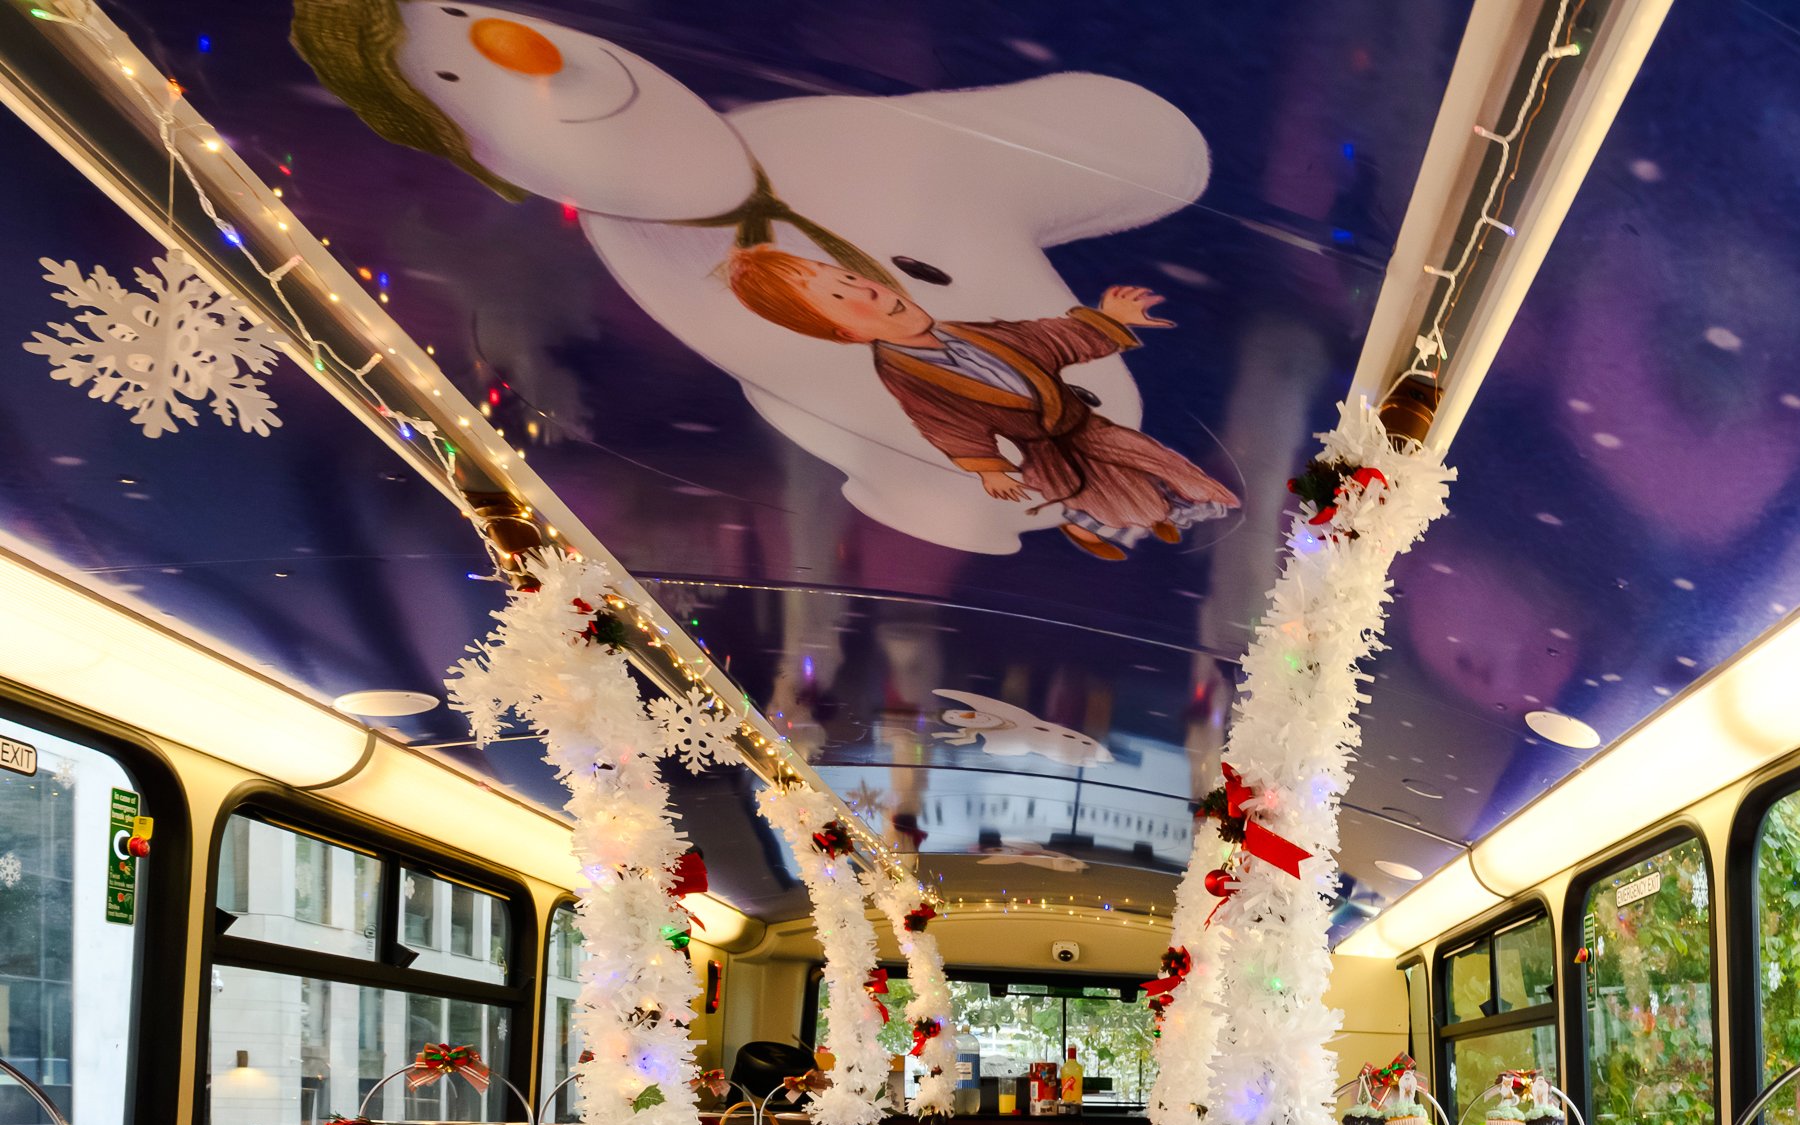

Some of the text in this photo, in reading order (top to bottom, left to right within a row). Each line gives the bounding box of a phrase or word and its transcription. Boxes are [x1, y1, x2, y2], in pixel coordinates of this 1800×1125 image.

[1, 742, 33, 769] EXIT
[1617, 873, 1659, 905] EMERGENCY EXIT
